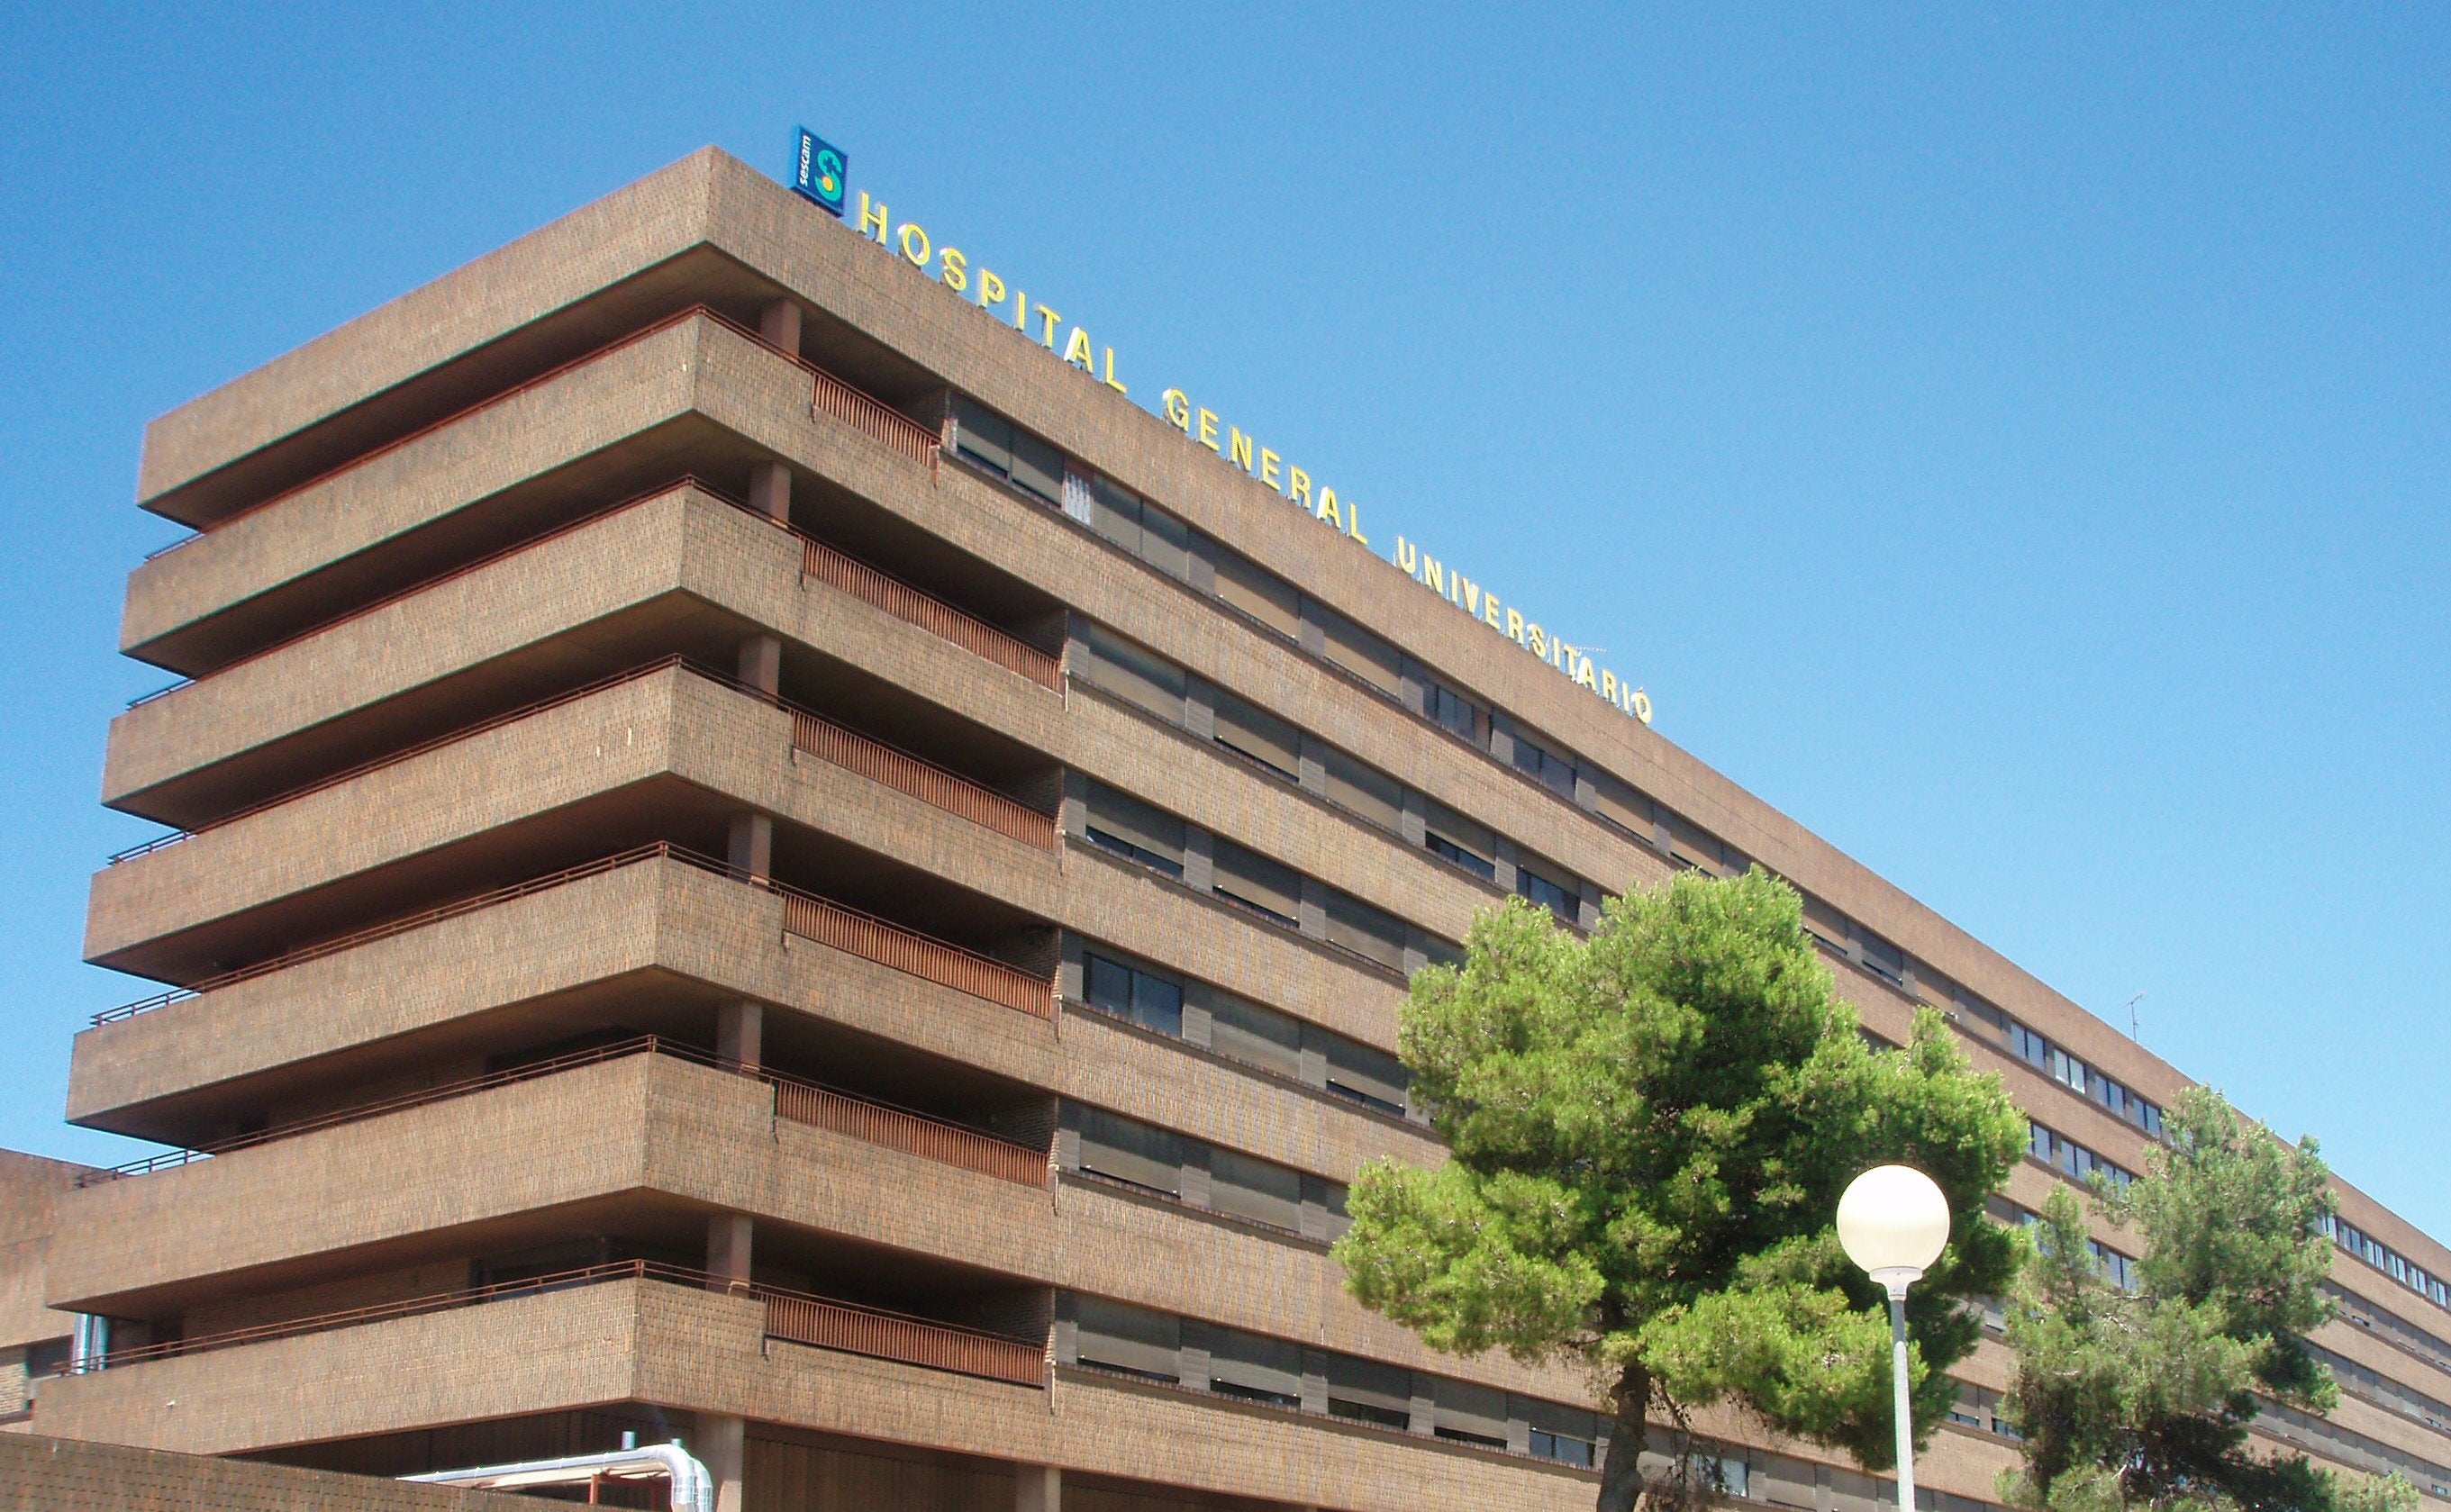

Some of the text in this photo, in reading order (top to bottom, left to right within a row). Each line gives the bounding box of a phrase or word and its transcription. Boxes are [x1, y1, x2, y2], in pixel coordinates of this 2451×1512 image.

[800, 134, 811, 186] sescam
[858, 192, 1652, 723] HOSPITAL GENERAL UNIVERSITARIO
